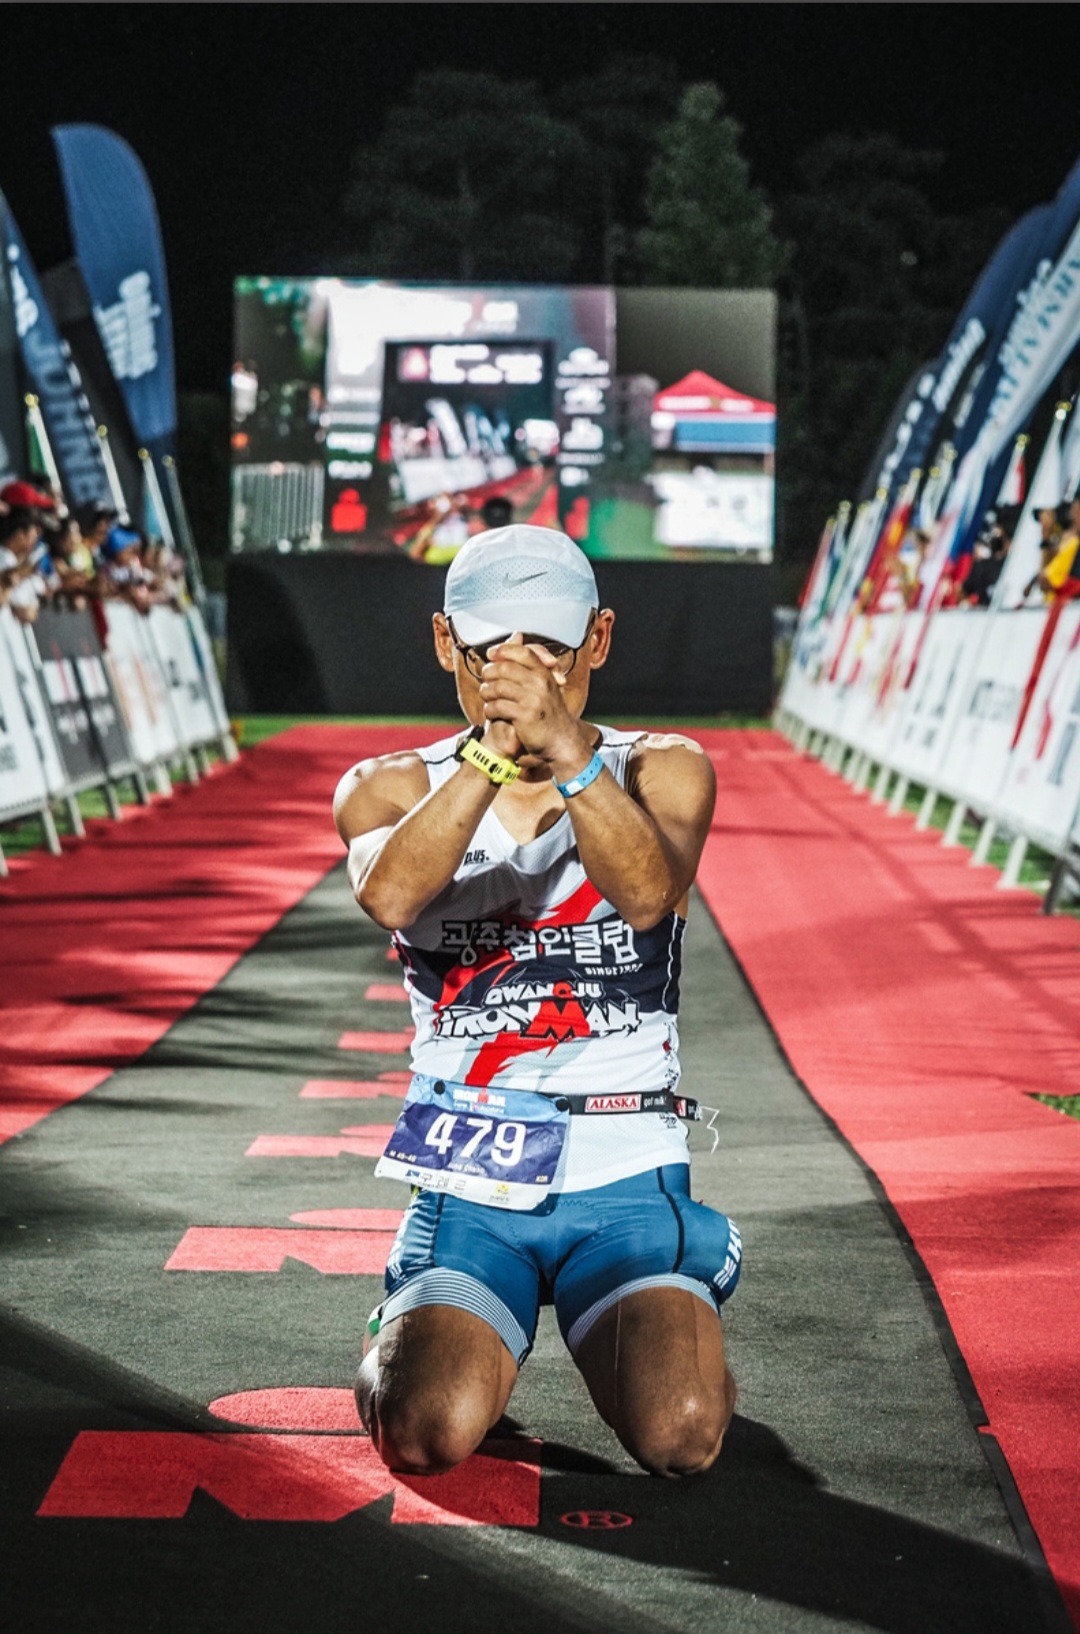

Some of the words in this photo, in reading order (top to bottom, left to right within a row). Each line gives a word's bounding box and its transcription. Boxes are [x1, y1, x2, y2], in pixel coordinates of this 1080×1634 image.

[484, 980, 602, 1006] GWANGJU
[438, 1001, 640, 1040] IRONMAN
[590, 1097, 637, 1110] ALASKA
[425, 1112, 527, 1167] 479
